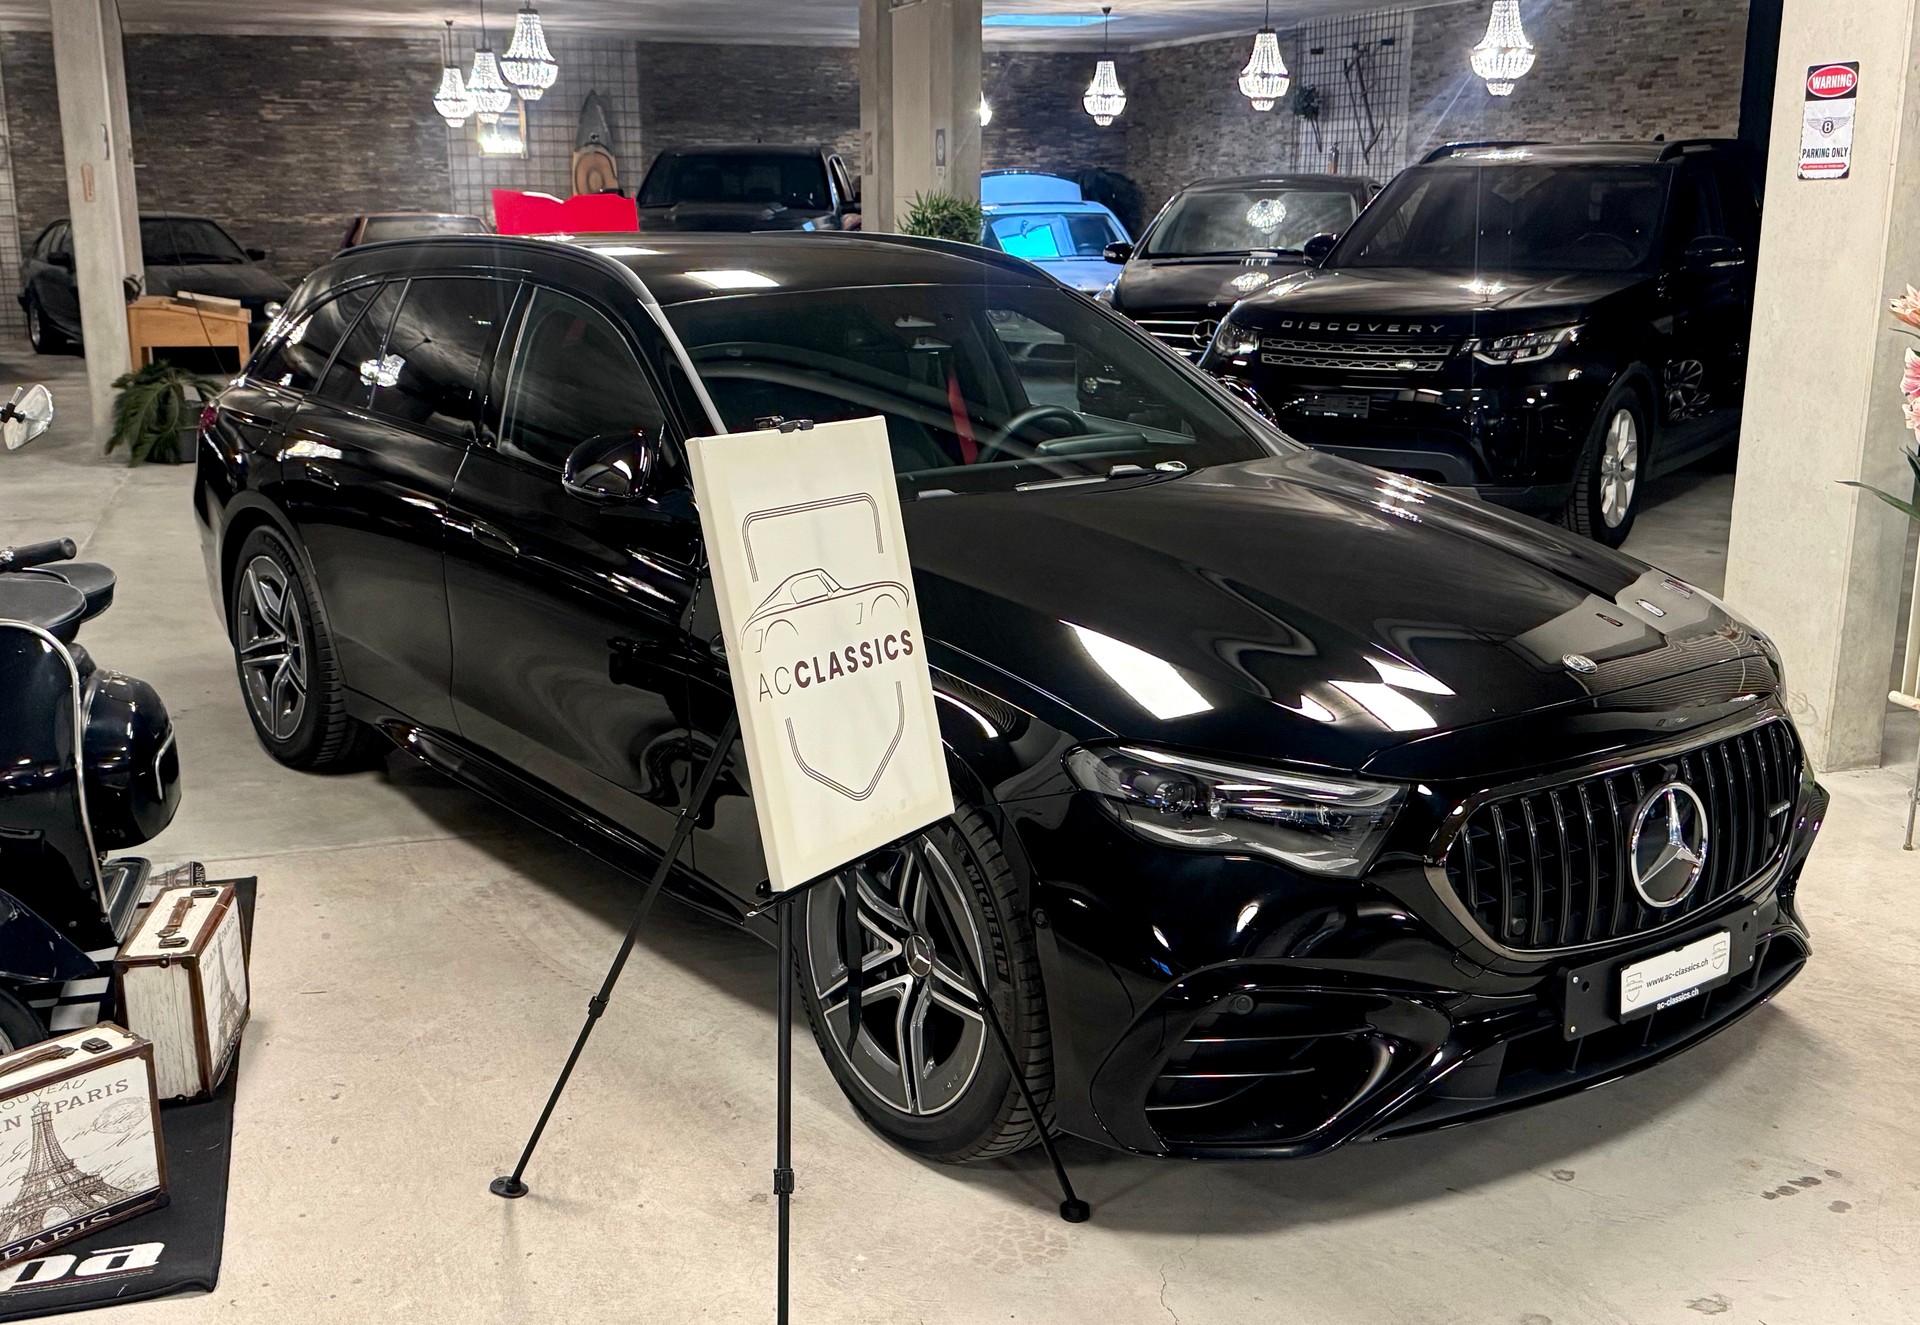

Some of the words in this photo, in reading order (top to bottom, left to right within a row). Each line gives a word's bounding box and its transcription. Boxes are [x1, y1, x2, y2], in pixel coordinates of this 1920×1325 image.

[1812, 74, 1853, 90] WARNING
[1802, 148, 1830, 159] PARKING
[1831, 147, 1849, 158] ONLY
[1281, 320, 1445, 333] DISCOVERY
[964, 864, 1010, 977] MICHELIN
[1646, 957, 1709, 988] www.ac-classics.ch
[1656, 987, 1699, 1010] ac-classics.ch
[0, 1079, 87, 1114] OUVEAU
[54, 1079, 129, 1115] PARIS
[2, 1212, 113, 1260] PARIS
